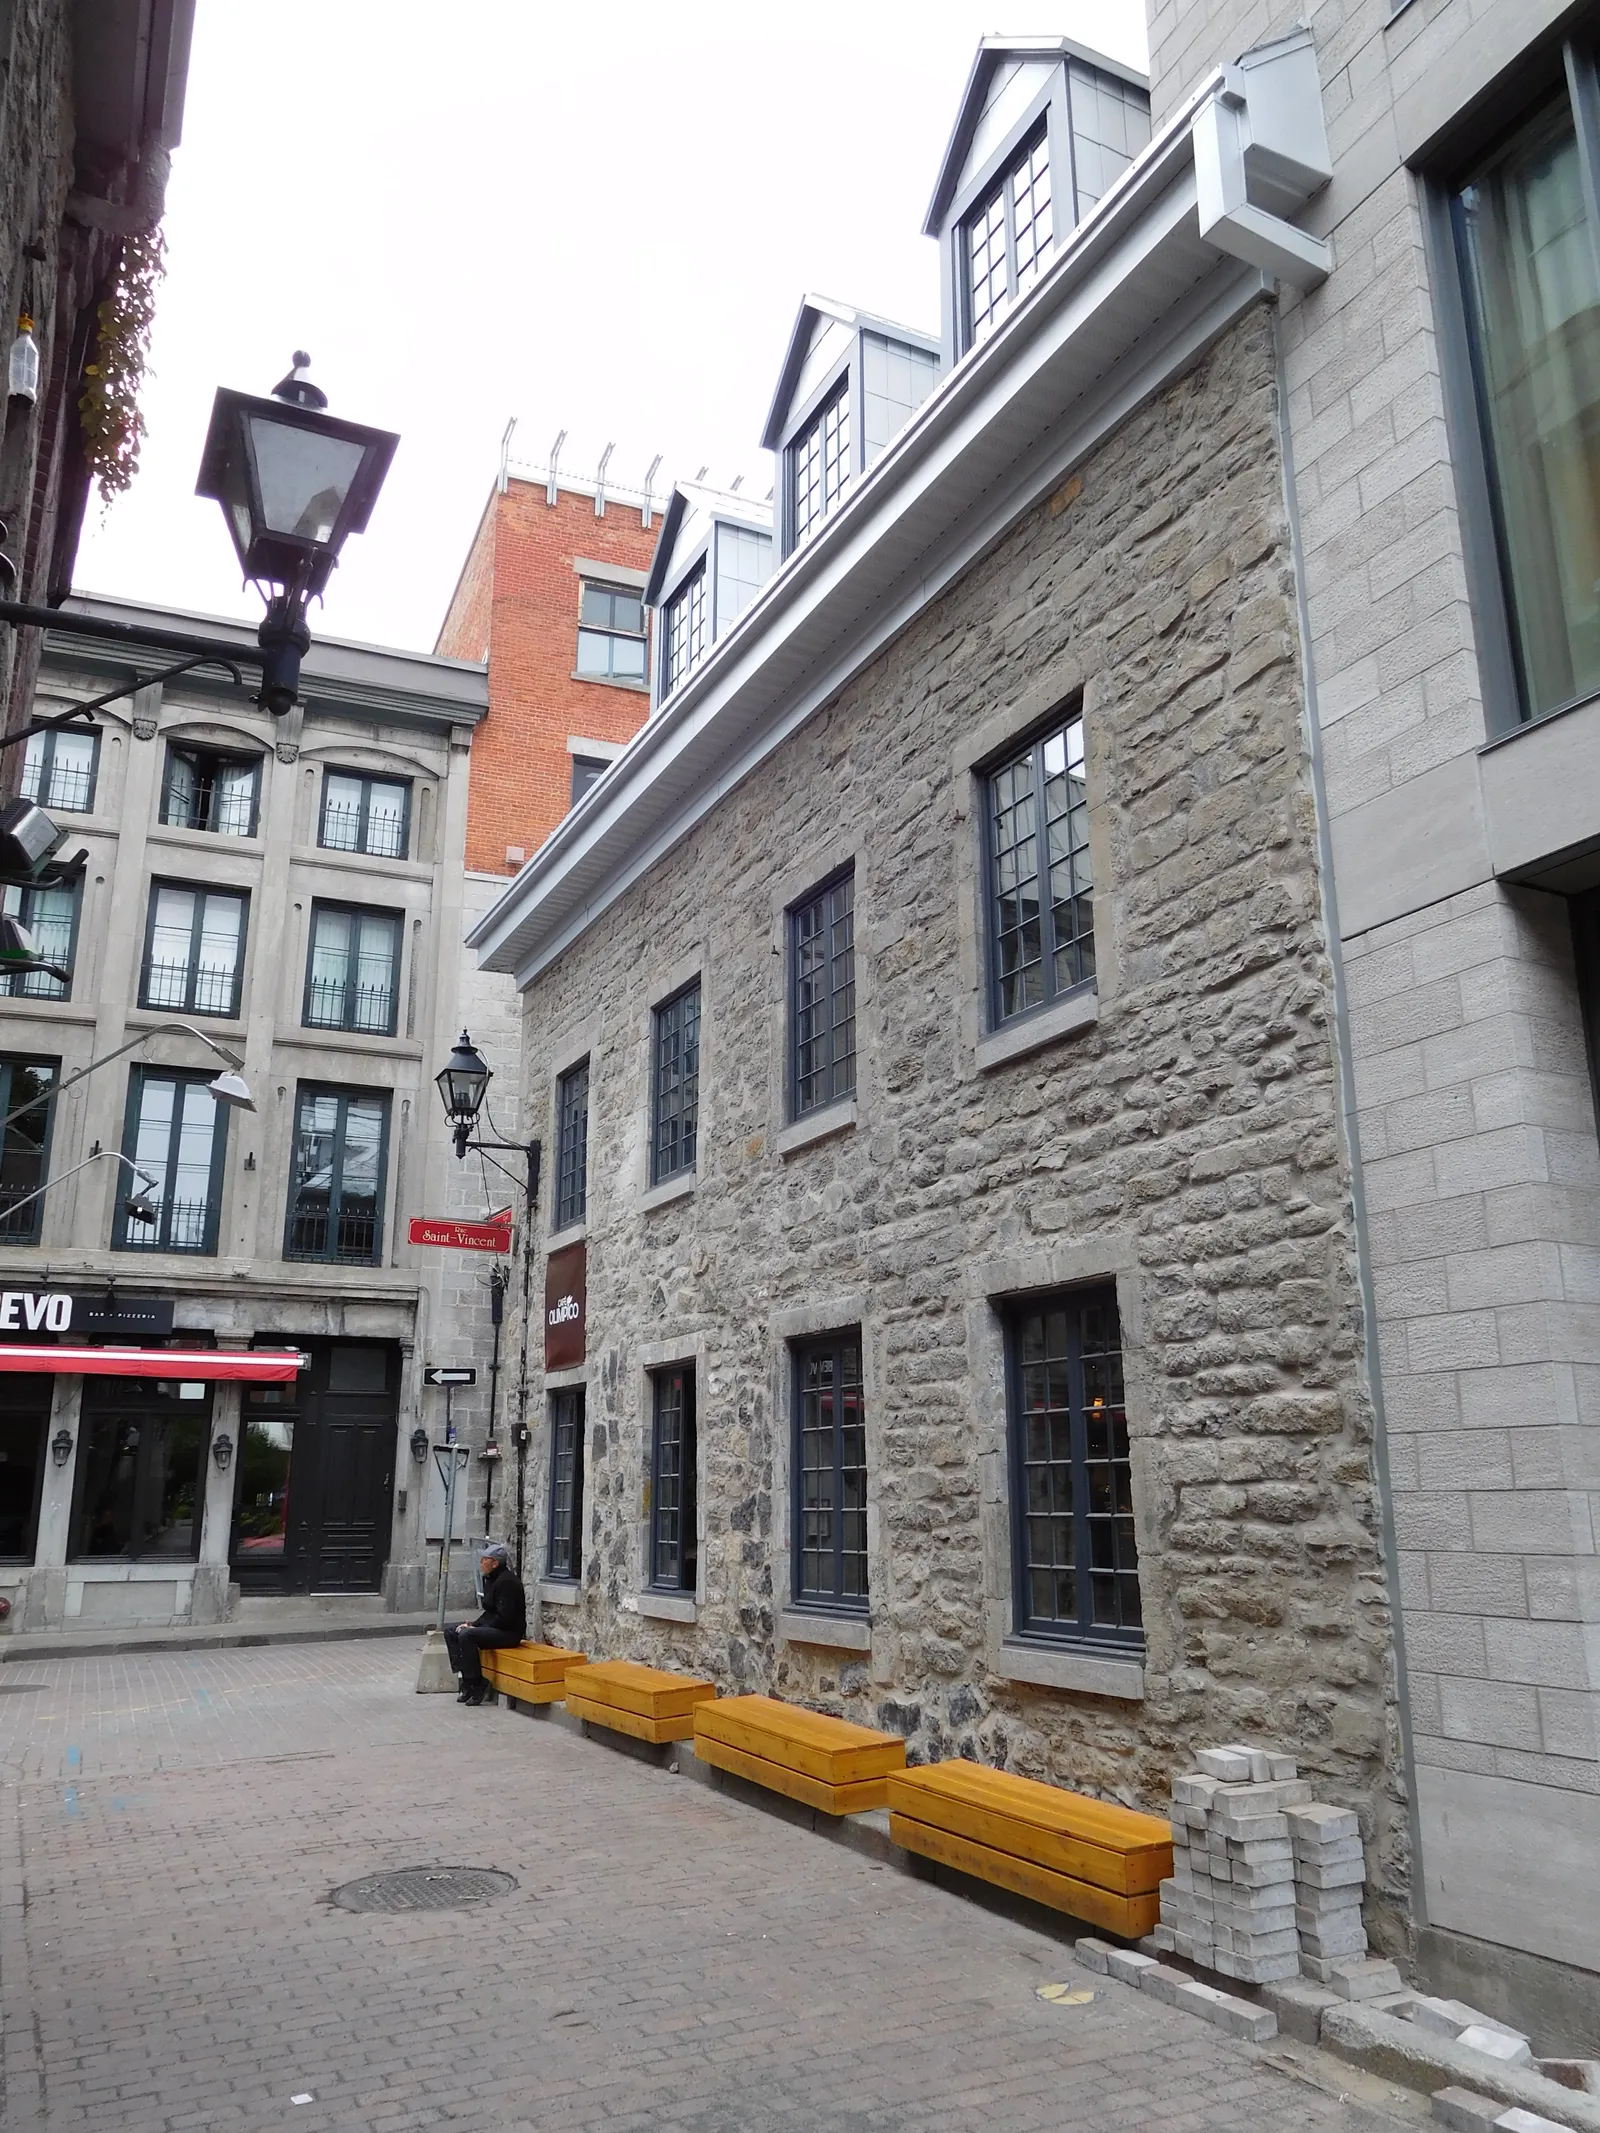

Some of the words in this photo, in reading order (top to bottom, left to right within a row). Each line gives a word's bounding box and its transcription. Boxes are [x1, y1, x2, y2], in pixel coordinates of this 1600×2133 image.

[422, 1230, 496, 1247] Saint-Vincent
[0, 1292, 73, 1331] EVO
[548, 1302, 579, 1325] OLIMPICO
